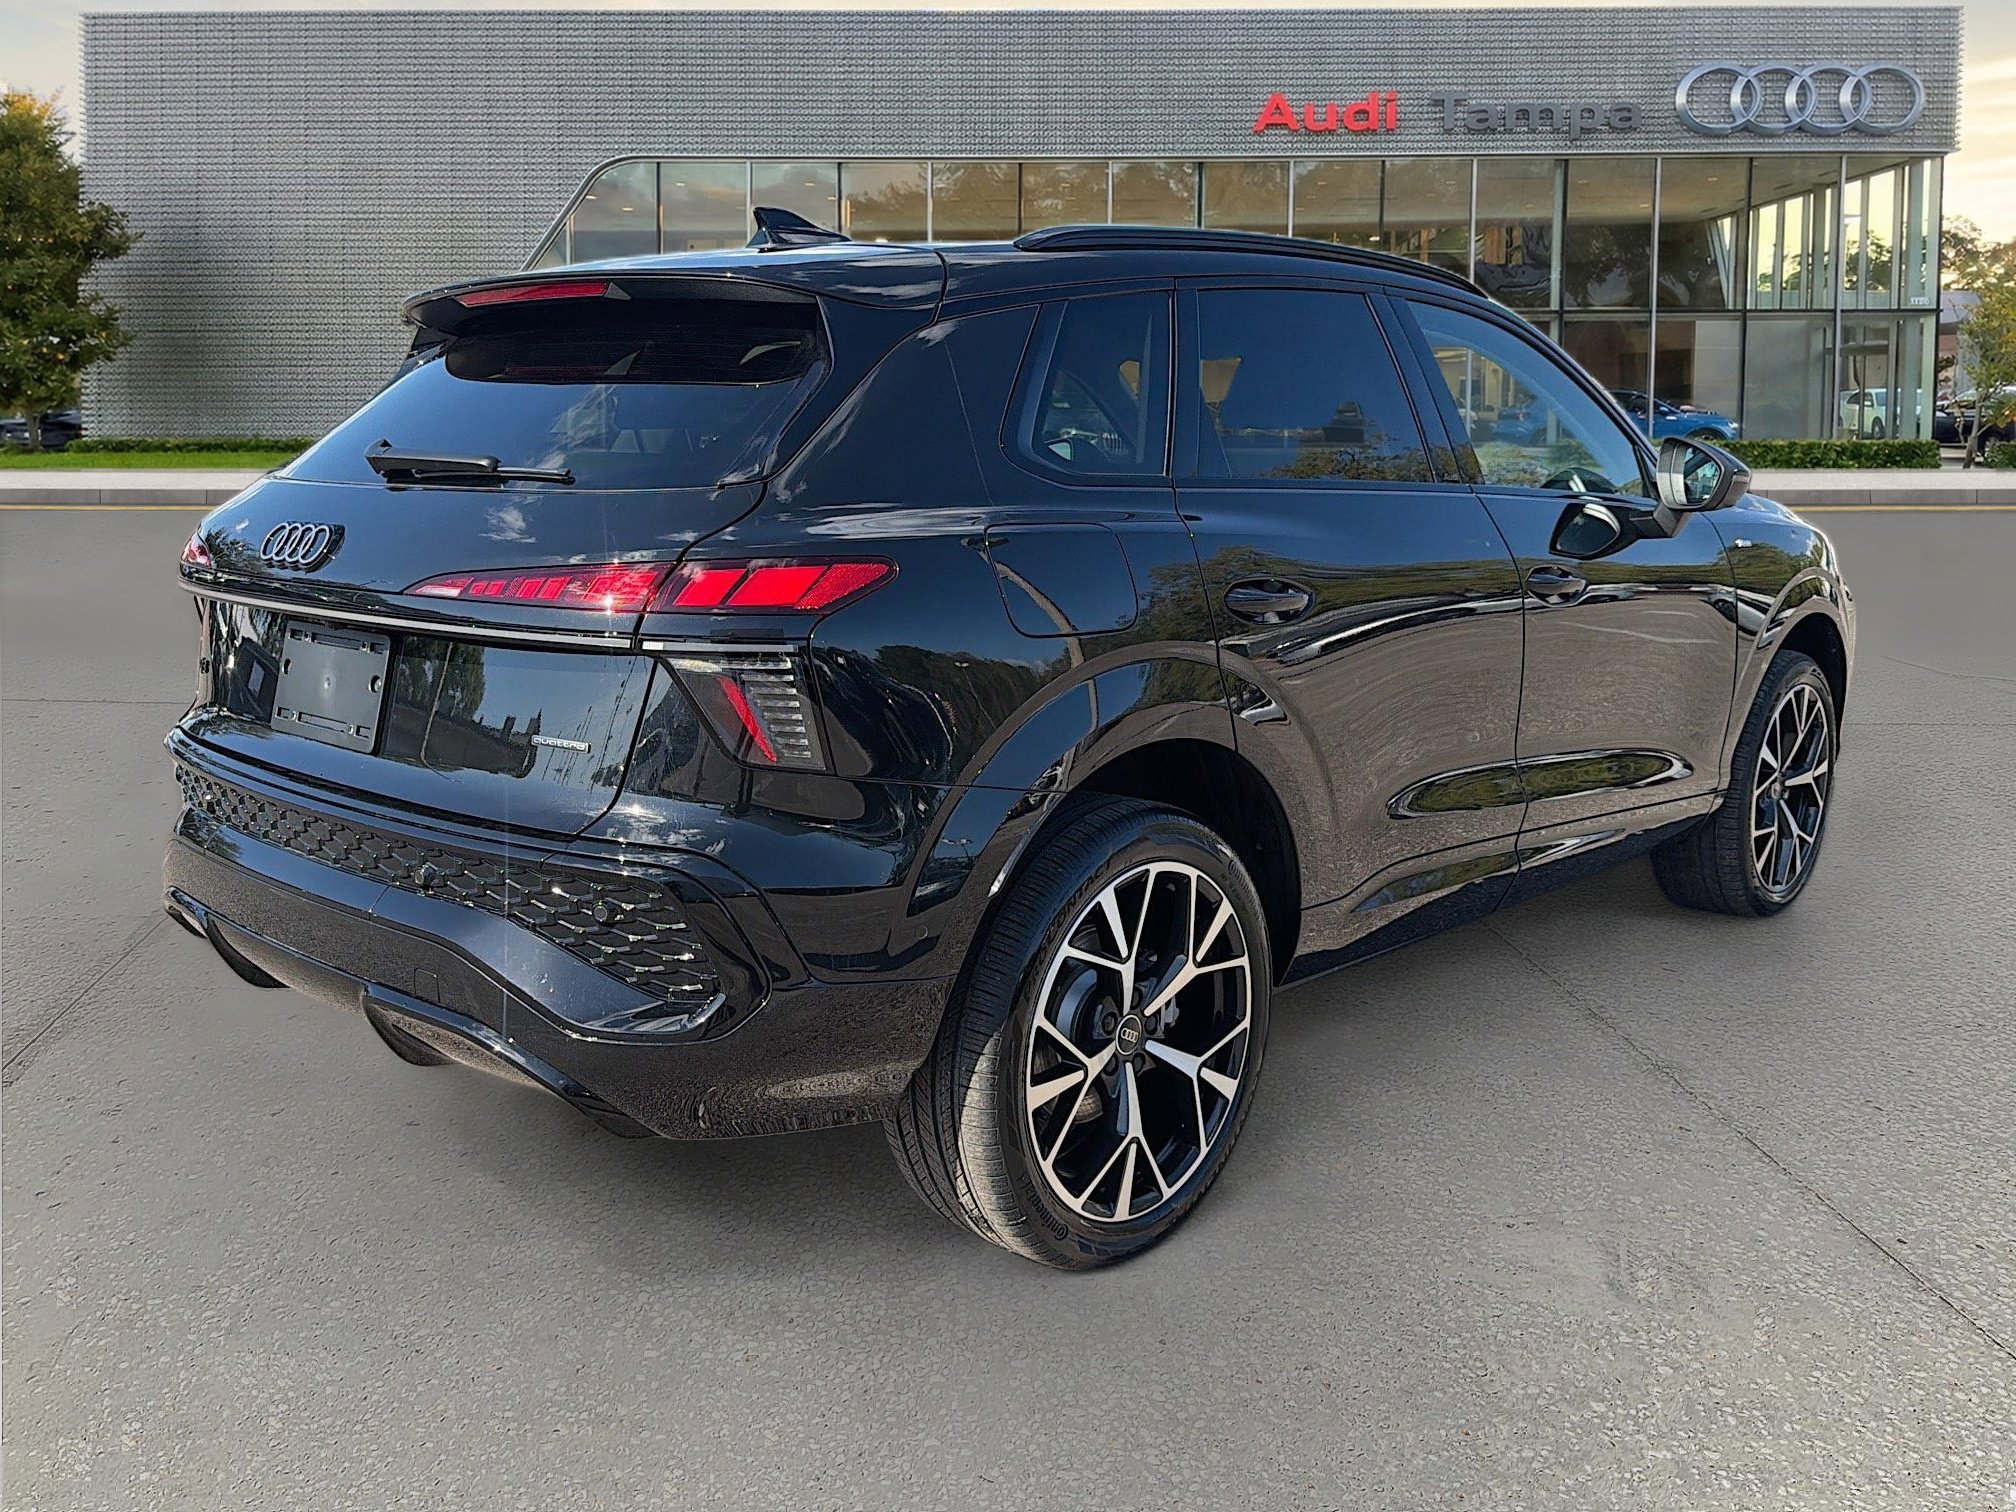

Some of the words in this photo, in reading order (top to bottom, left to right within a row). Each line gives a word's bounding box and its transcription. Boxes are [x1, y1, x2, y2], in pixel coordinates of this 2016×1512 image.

[1253, 91, 1397, 132] Audi
[1430, 91, 1642, 141] Tampa
[533, 736, 586, 751] quattro
[1020, 1181, 1069, 1240] Continental
